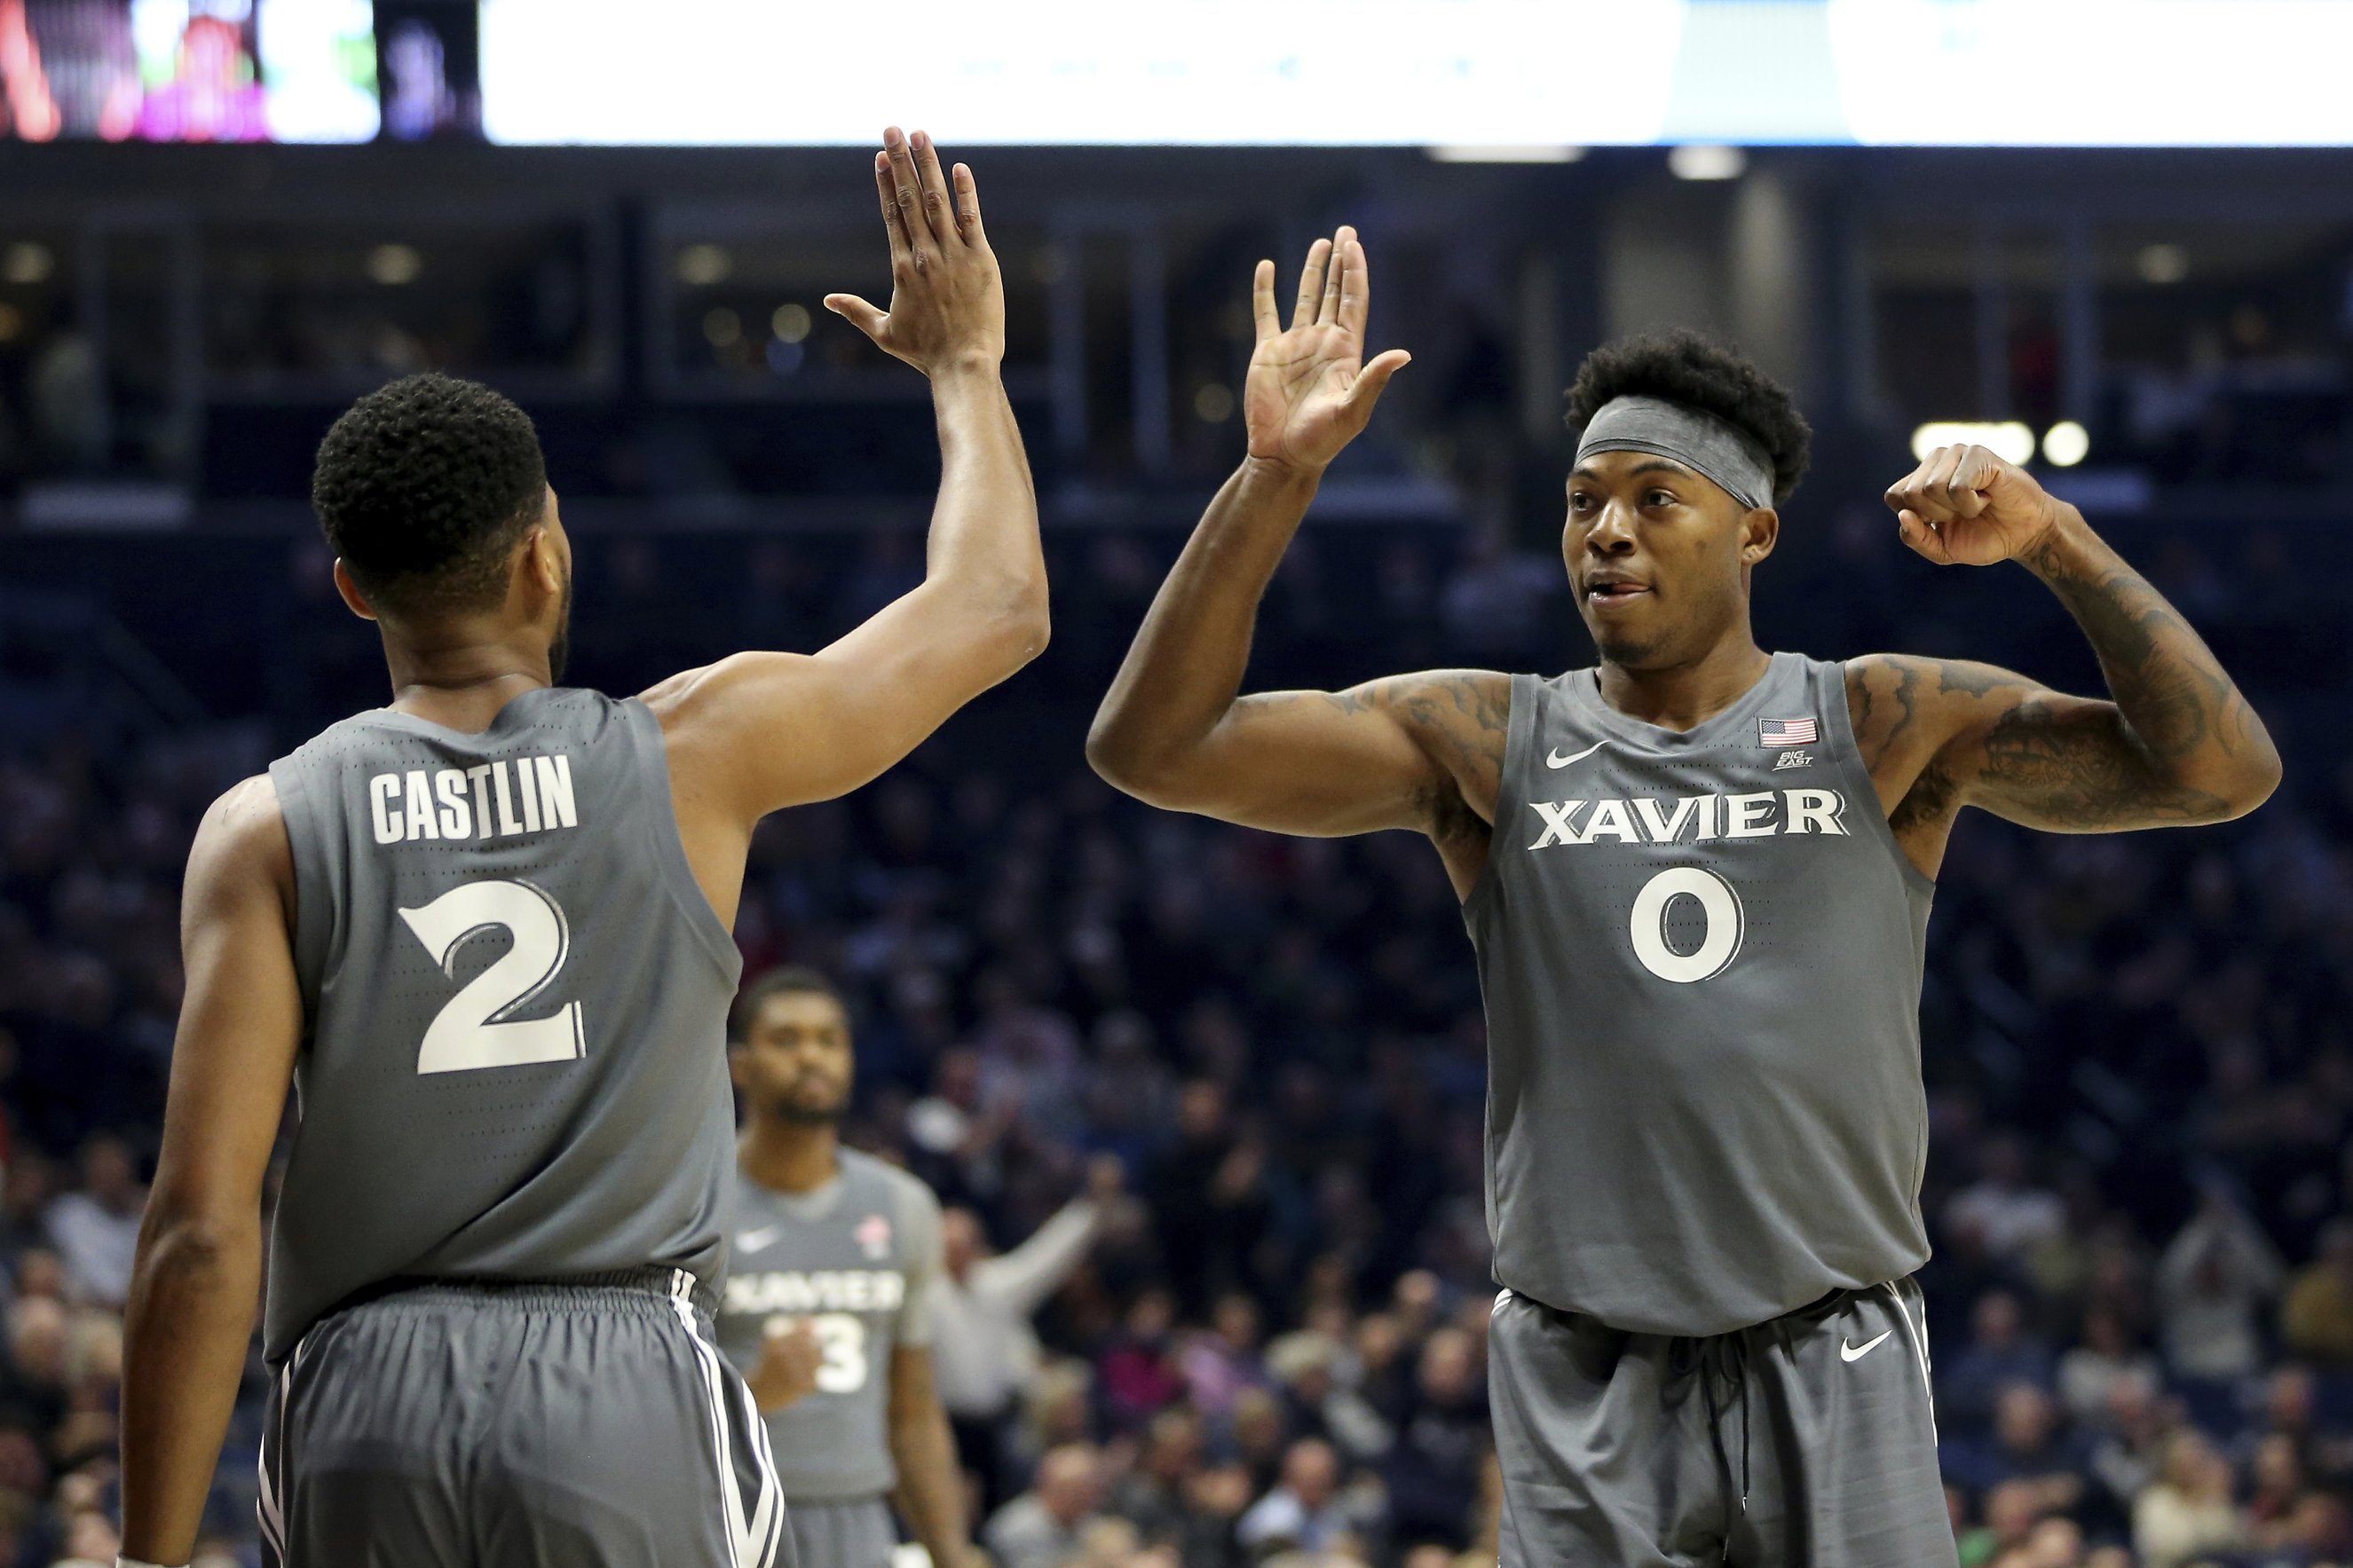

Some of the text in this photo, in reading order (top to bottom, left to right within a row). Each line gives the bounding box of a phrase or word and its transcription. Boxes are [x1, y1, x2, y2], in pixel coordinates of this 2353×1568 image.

[1776, 757, 1813, 767] EAST
[1780, 750, 1805, 760] BIG
[369, 754, 578, 845] CASTLIN
[1528, 788, 1851, 850] XAVIER
[1630, 866, 1745, 983] 0
[398, 878, 587, 1076] 2
[762, 1312, 867, 1393] 3
